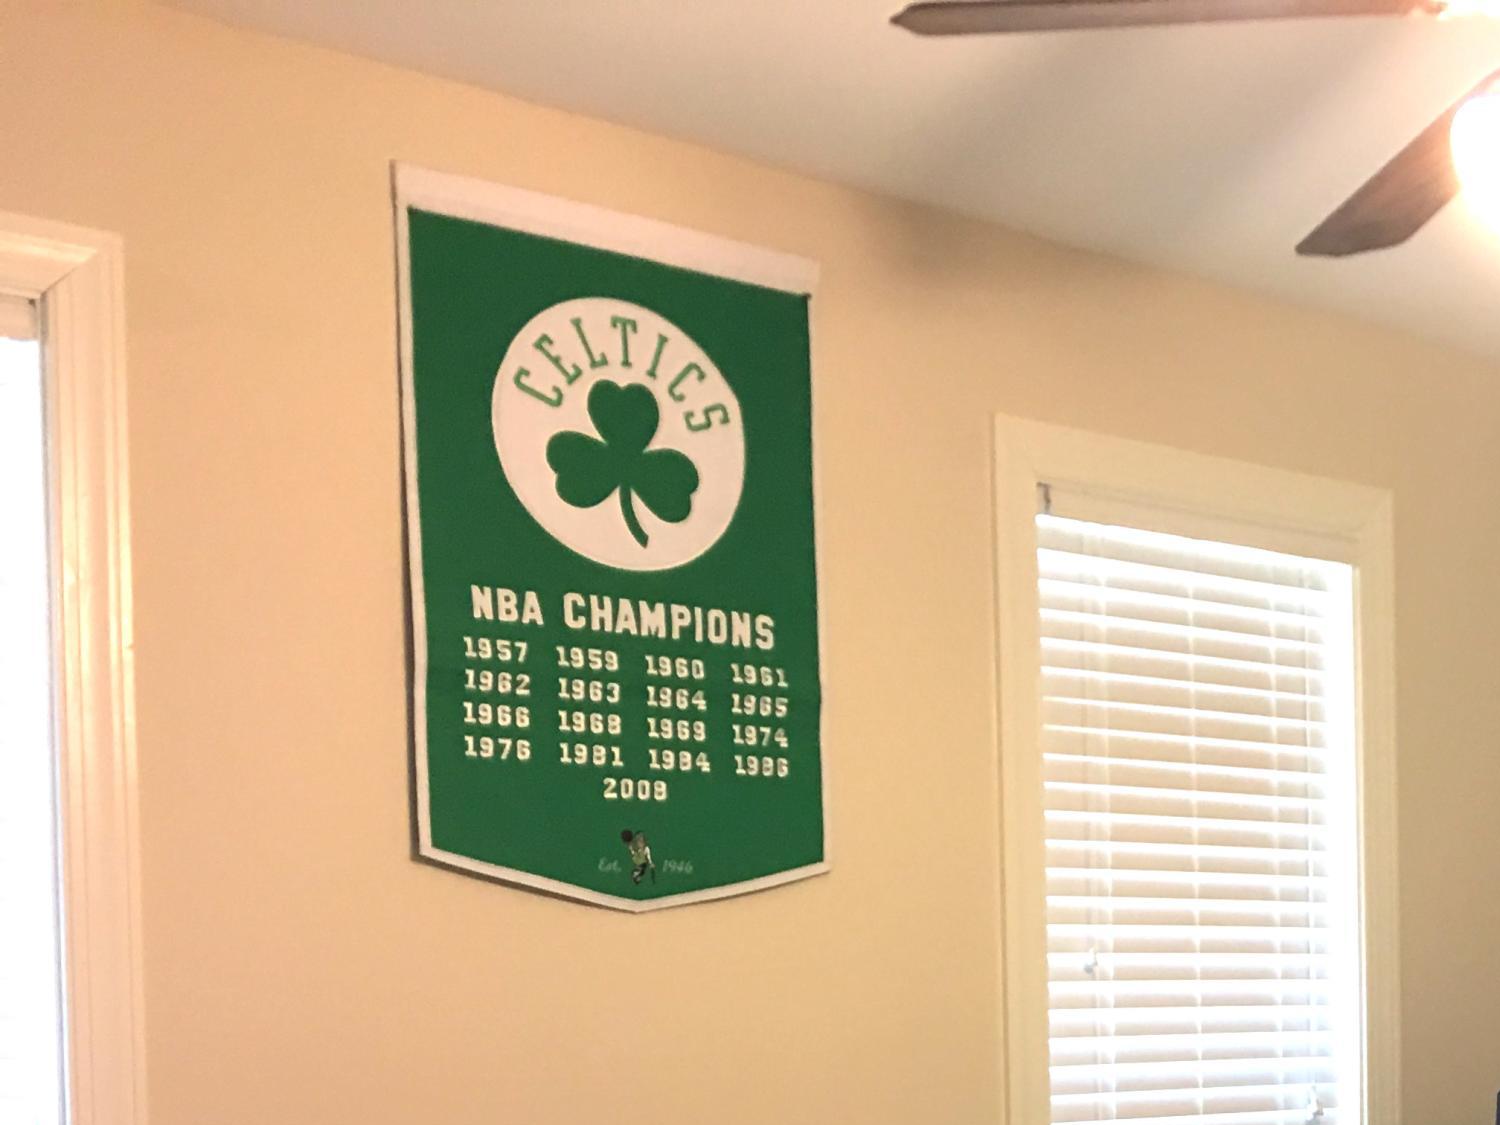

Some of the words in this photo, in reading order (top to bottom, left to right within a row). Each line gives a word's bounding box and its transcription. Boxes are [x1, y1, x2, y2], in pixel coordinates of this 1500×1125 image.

[513, 317, 730, 432] CELTICS
[471, 585, 544, 625] NBA
[563, 593, 775, 649] CHAMPIONS
[464, 637, 527, 662] 1957
[557, 646, 618, 671] 1959
[645, 656, 704, 679] 1960
[731, 664, 788, 687] 1961
[465, 669, 530, 695] 1962
[559, 678, 620, 703] 1963
[647, 686, 706, 710] 1964
[732, 694, 788, 717] 1965
[464, 702, 529, 727] 1966
[559, 710, 621, 735] 1968
[648, 718, 705, 741] 1969
[733, 725, 788, 747] 1974
[465, 736, 530, 760] 1976
[560, 743, 623, 766] 1981
[649, 749, 710, 772] 1984
[735, 756, 788, 777] 1986
[604, 778, 667, 801] 2008
[662, 859, 693, 874] 1946
